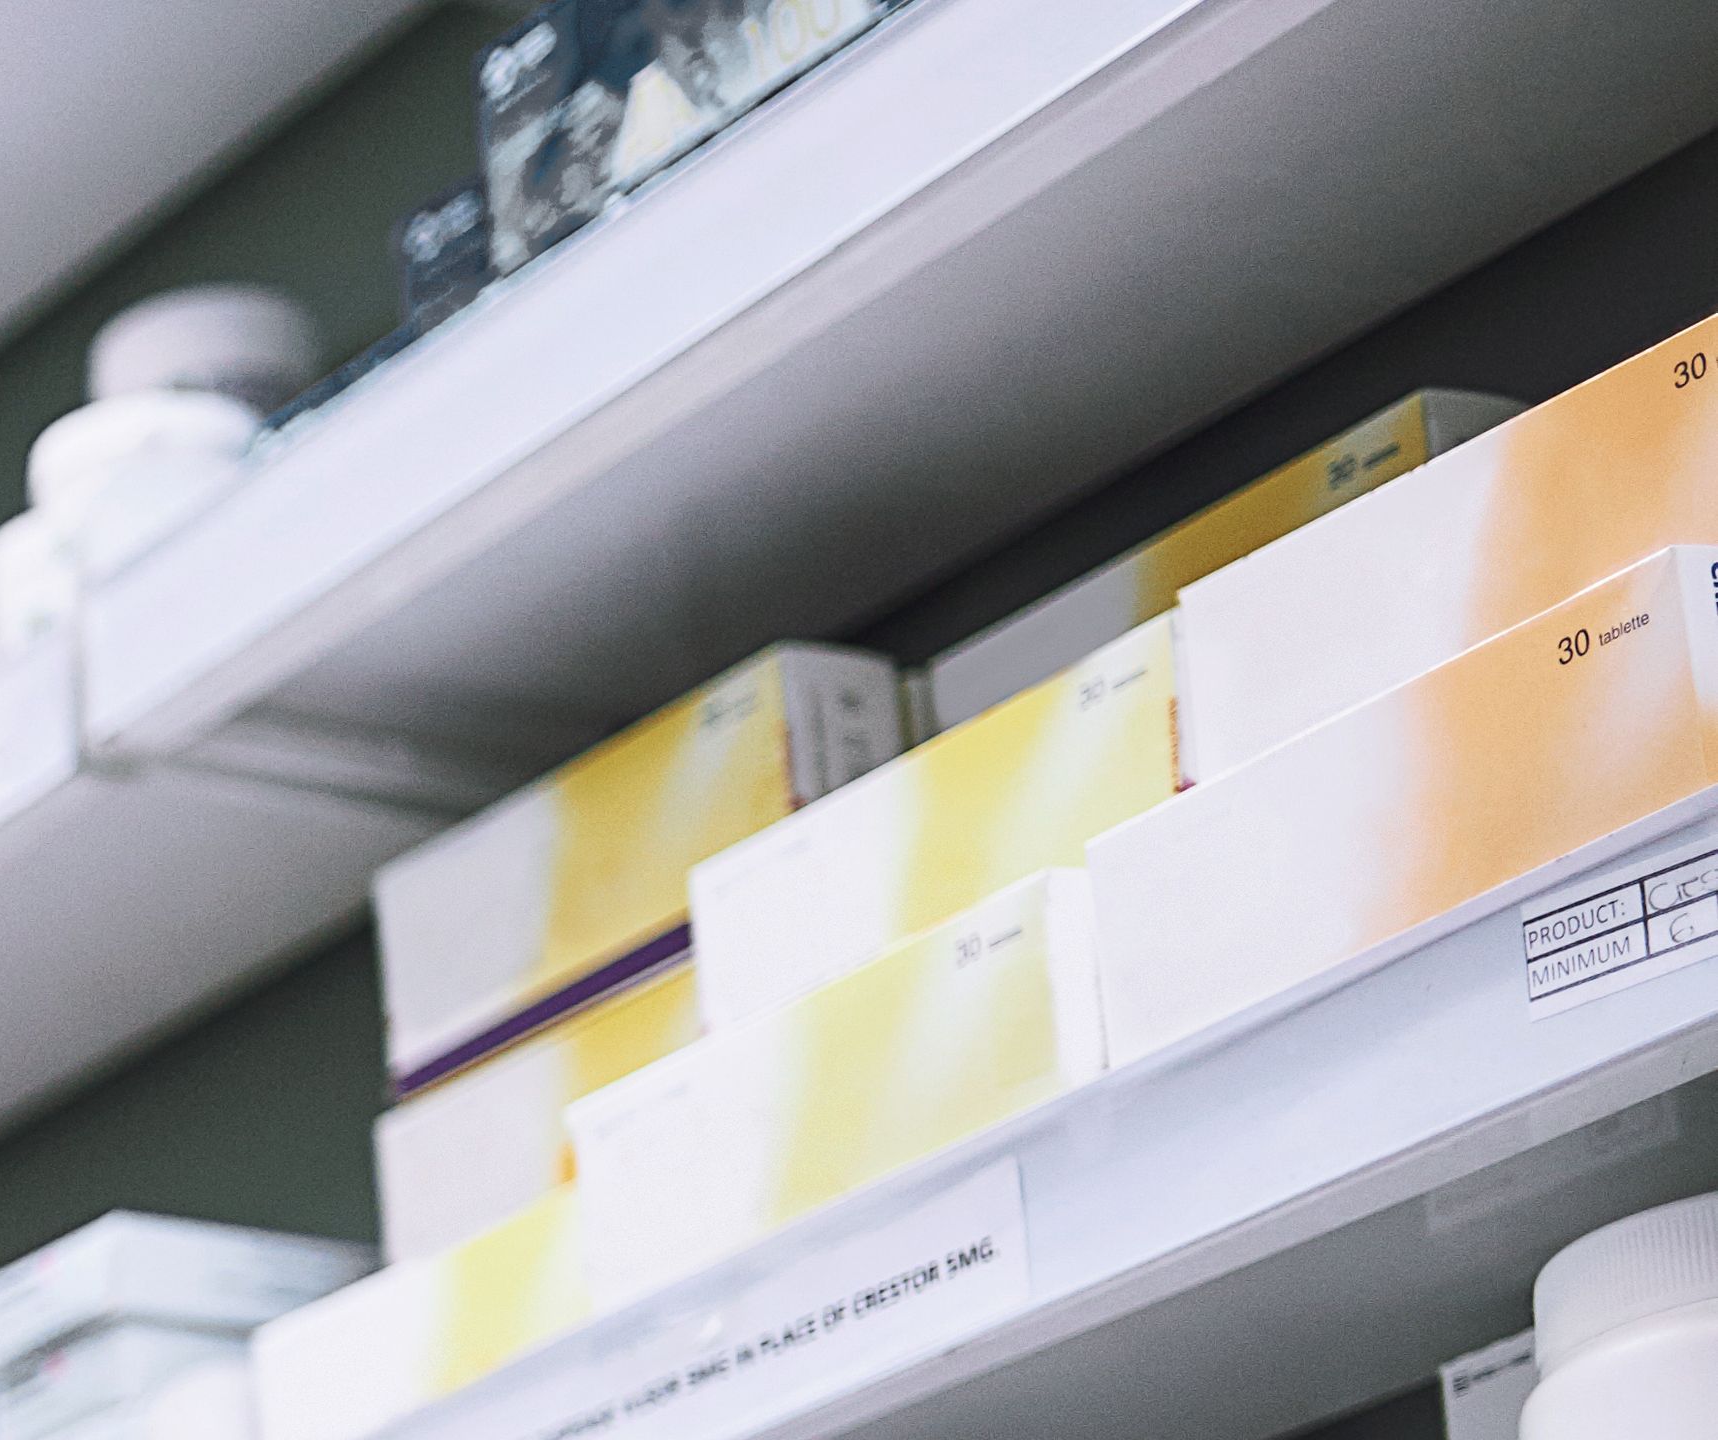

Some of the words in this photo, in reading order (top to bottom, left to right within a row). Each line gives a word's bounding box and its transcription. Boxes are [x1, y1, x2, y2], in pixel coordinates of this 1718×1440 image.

[1674, 352, 1707, 389] 30
[1557, 628, 1590, 665] 30
[1598, 612, 1651, 646] tablette
[1528, 899, 1626, 950] PRODUCT:
[1532, 936, 1631, 988] MINIMUM
[822, 1297, 846, 1332] OF
[853, 1260, 939, 1320] CRESTOR
